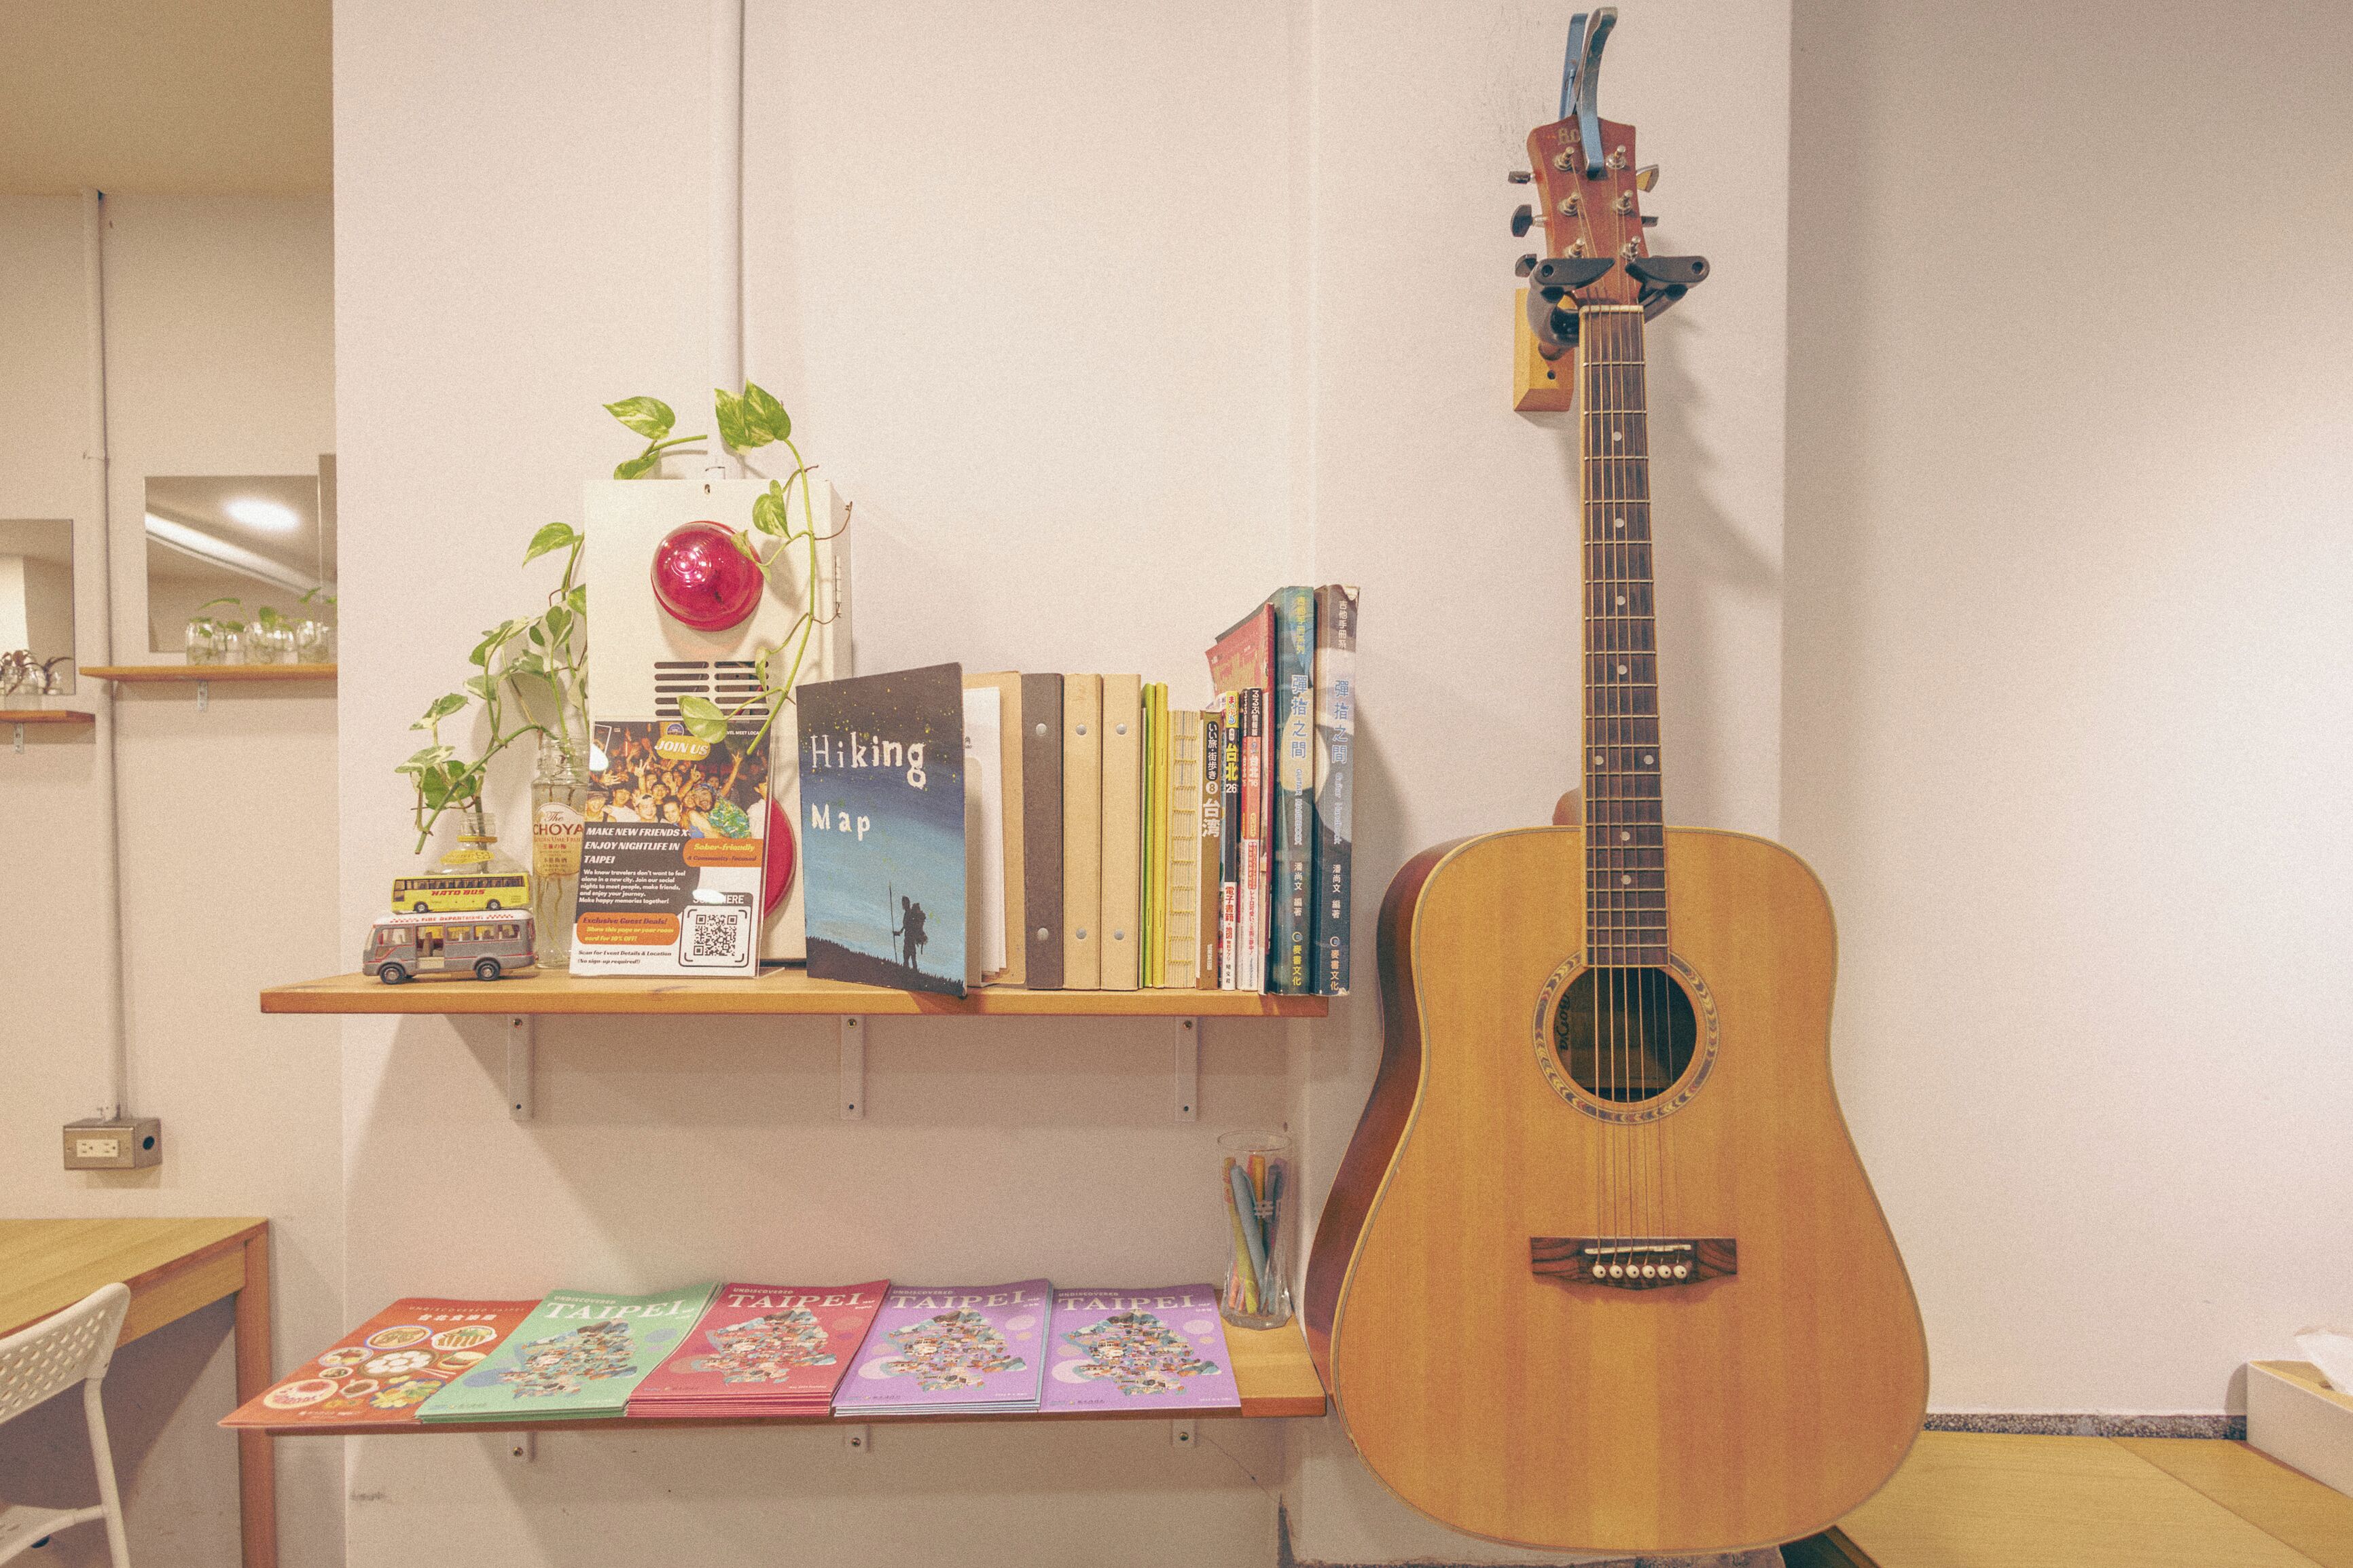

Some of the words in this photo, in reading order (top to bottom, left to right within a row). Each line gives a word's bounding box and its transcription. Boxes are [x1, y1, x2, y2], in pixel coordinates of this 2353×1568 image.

[1291, 675, 1308, 759] 彈指之間
[1333, 680, 1350, 764] 彈指之間
[654, 740, 689, 754] JOIN
[689, 744, 708, 756] US
[1208, 723, 1217, 780] いい旅・街歩き
[810, 731, 927, 790] Hiking
[1225, 742, 1238, 781] 台北
[544, 811, 564, 822] The
[812, 802, 871, 841] Map
[1202, 798, 1221, 837] 台湾
[533, 822, 583, 835] CHOYA
[586, 828, 615, 836] MAKE
[615, 828, 639, 836] NEW
[639, 828, 681, 837] FRIENDS
[584, 841, 617, 850] ENJOY
[618, 842, 668, 851] NIGHTLIFE
[668, 842, 681, 851] IN
[584, 855, 615, 864] TAIPEI
[1294, 862, 1303, 890] 潘尚文
[1332, 864, 1341, 892] 潘尚文
[1293, 898, 1302, 917] 編著
[1331, 900, 1341, 919] 編著
[1293, 945, 1302, 986] 麥書文化
[1330, 950, 1340, 991] 麥書文化
[544, 1299, 685, 1319] TAIPEI
[554, 1295, 617, 1305] UNDISCOVERED
[728, 1292, 865, 1308] TAIPEI
[890, 1290, 1026, 1309] TAIPEI
[1058, 1294, 1195, 1311] TAIPEI
